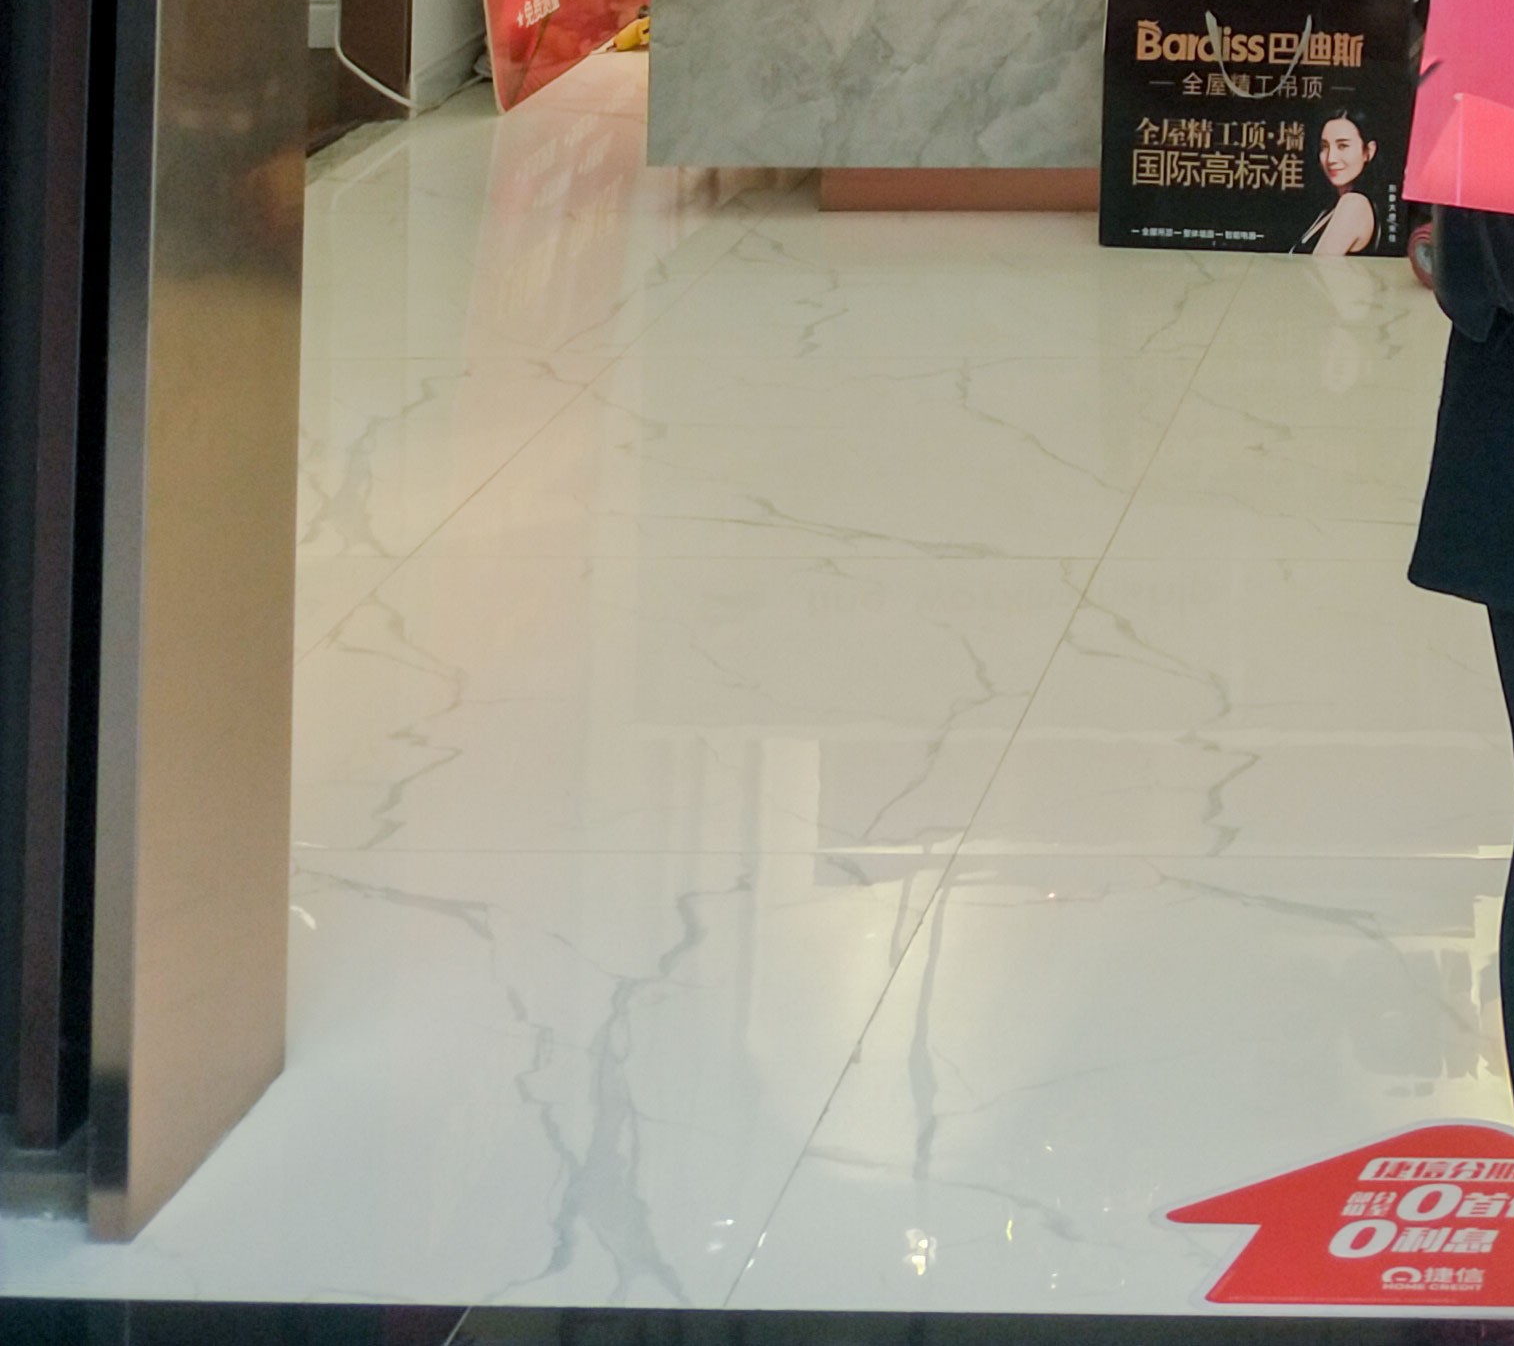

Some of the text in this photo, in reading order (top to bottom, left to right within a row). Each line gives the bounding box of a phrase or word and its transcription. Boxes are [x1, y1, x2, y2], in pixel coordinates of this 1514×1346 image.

[1136, 20, 1265, 63] Bardiss
[1132, 149, 1305, 191] 国际高标准
[1328, 1219, 1498, 1258] 0利息
